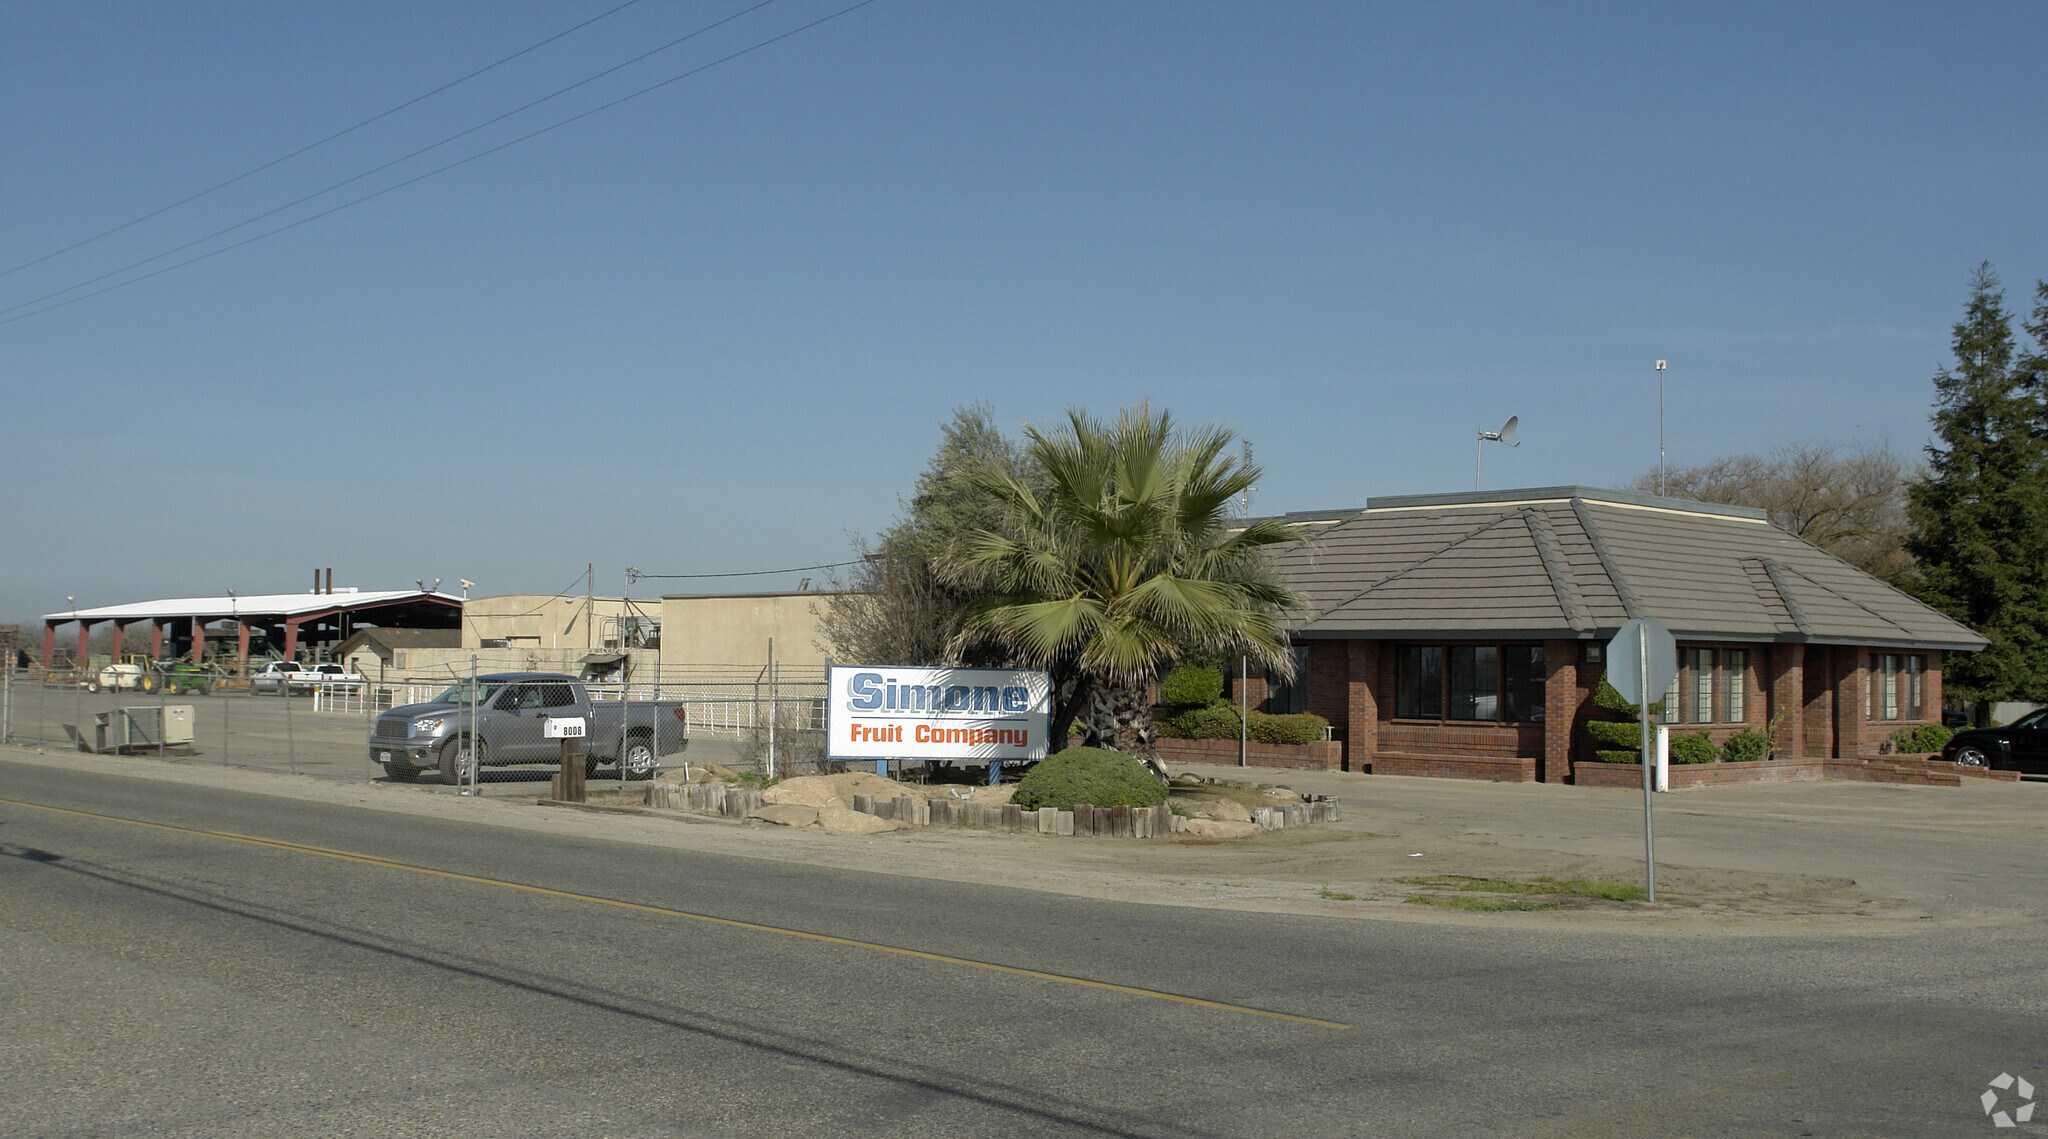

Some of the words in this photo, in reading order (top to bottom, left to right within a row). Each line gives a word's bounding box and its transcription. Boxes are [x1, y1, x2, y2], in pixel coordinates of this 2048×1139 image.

[848, 673, 1029, 713] Simone
[563, 726, 582, 736] 8008
[851, 724, 903, 743] Fruit
[915, 724, 1029, 747] Company
